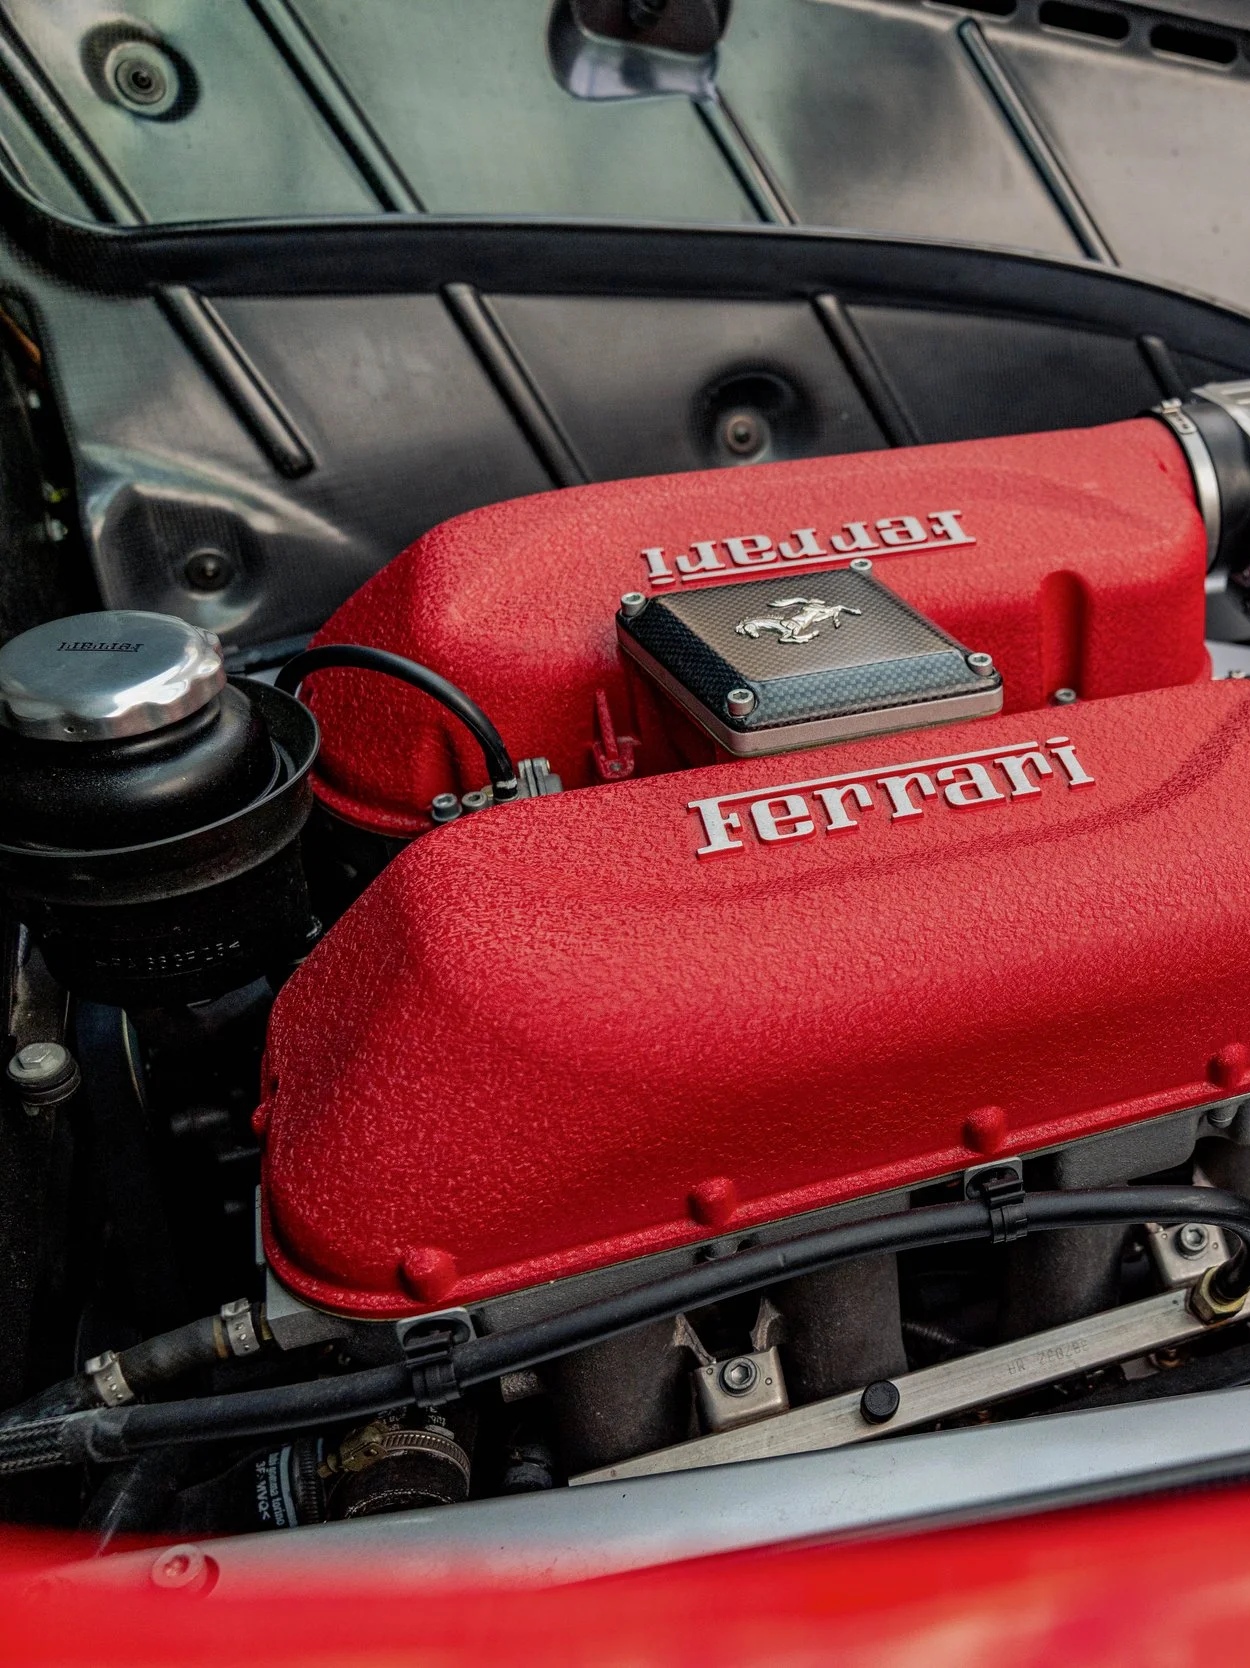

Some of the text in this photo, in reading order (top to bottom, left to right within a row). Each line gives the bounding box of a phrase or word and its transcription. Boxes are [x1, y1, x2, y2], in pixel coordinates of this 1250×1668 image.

[641, 509, 976, 585] Ferrari
[57, 641, 145, 654] Ferrari
[686, 736, 1095, 861] Ferrari
[272, 1497, 286, 1526] torino
